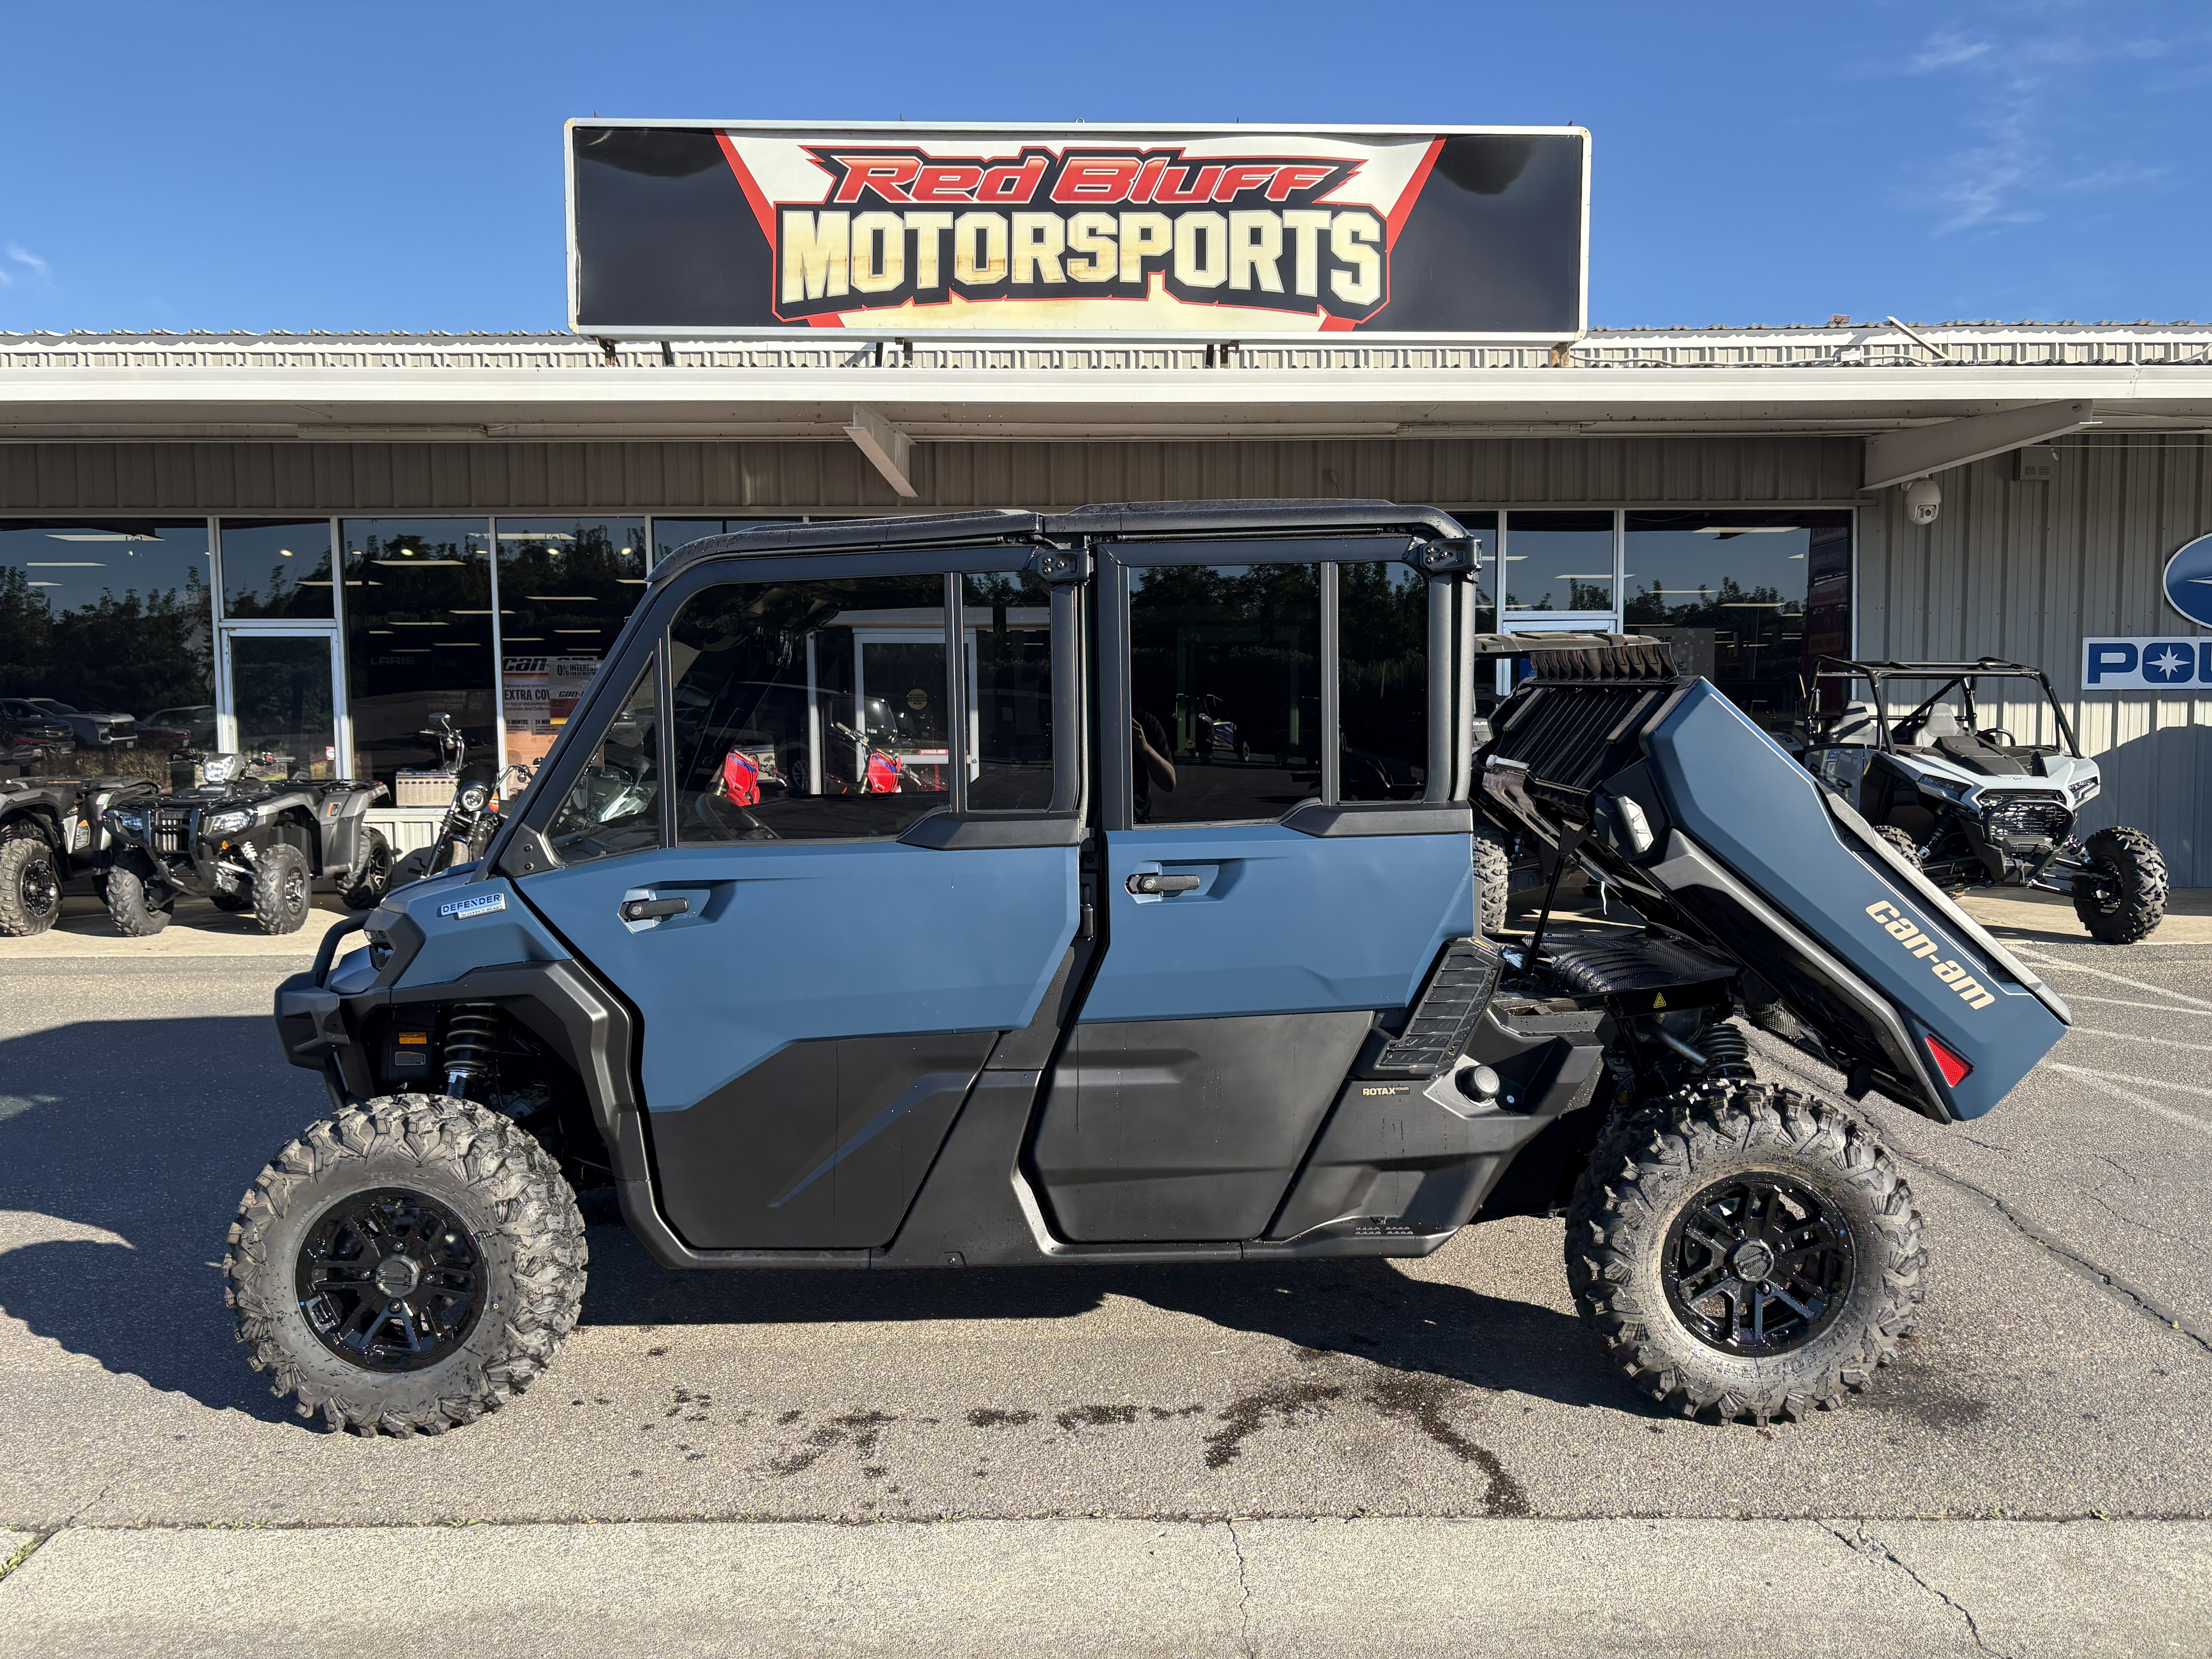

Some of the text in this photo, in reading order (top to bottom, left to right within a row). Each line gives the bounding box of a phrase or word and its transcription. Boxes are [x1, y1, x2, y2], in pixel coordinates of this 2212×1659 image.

[831, 155, 1049, 204] Red
[782, 210, 1381, 306] MOTORSPORTS
[370, 656, 415, 665] LARIS
[557, 665, 569, 676] 0%
[505, 689, 532, 700] EXTRA
[443, 894, 500, 913] DEFENDER
[1865, 900, 1995, 1010] can-am
[1363, 1087, 1396, 1096] ROTAX
